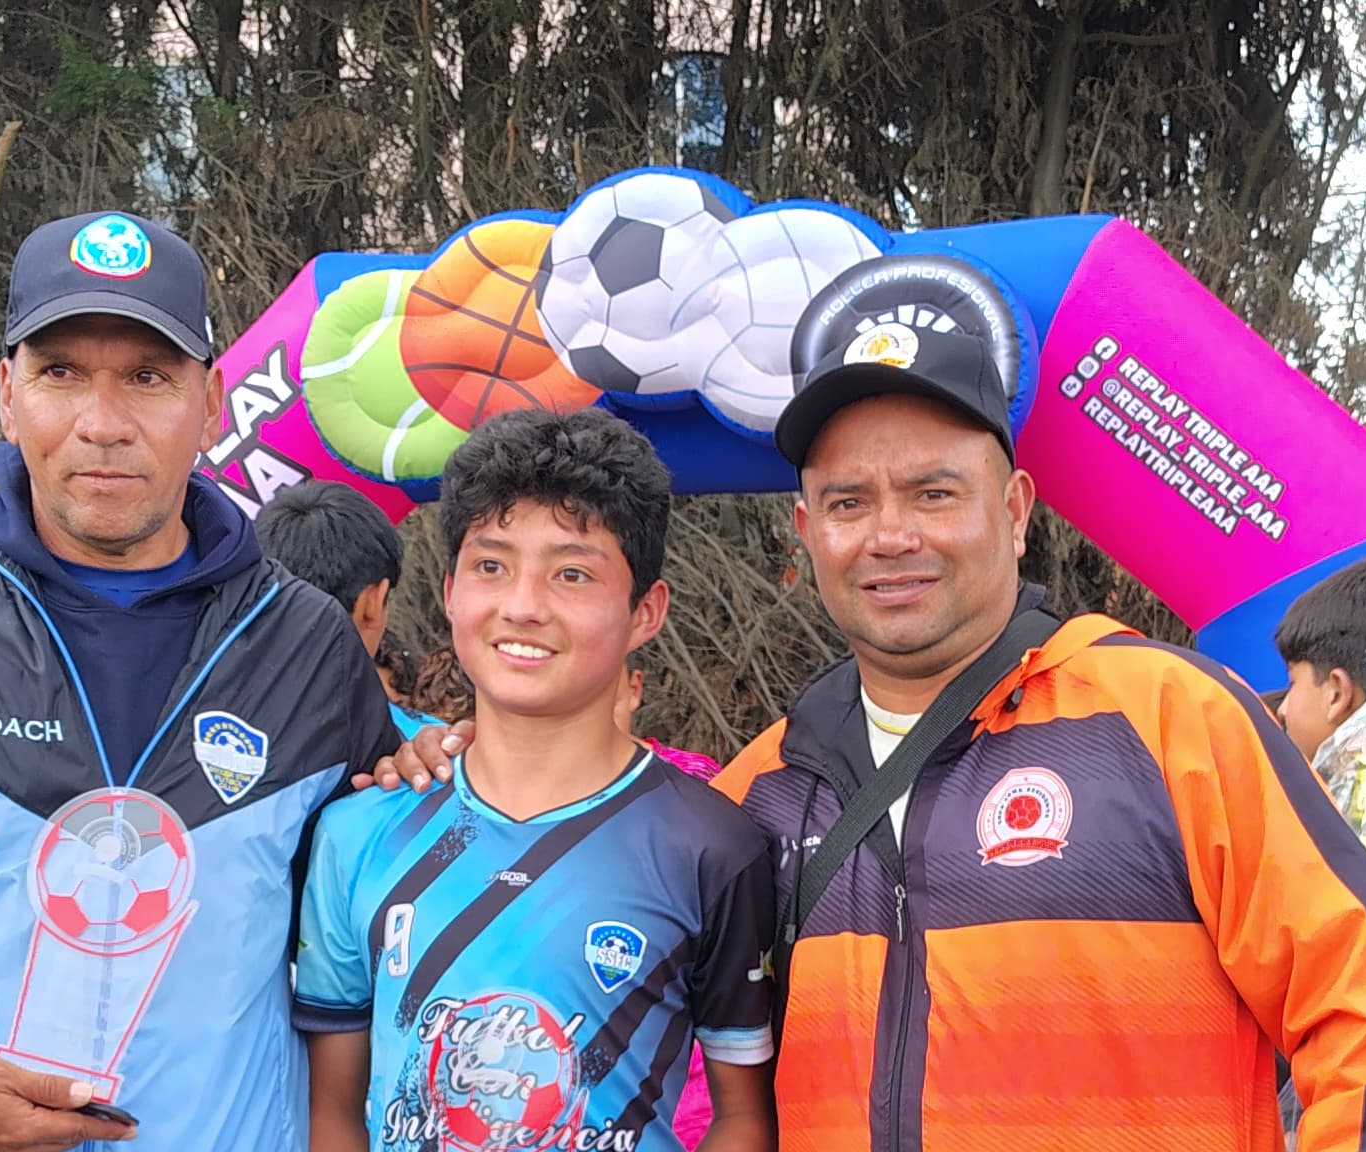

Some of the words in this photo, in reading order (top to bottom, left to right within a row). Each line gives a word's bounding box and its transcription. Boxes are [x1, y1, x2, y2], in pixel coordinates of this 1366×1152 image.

[892, 265, 1006, 342] PROFESIONAL
[194, 349, 294, 466] LAY
[1118, 356, 1190, 419] REPLAY
[1184, 411, 1259, 471] TRIPLE
[1241, 464, 1284, 502] AAA
[1083, 396, 1238, 534] REPLAYTRIPLEAAA
[384, 903, 415, 977] 9
[597, 947, 632, 970] SSFC
[418, 996, 586, 1055] Futbol
